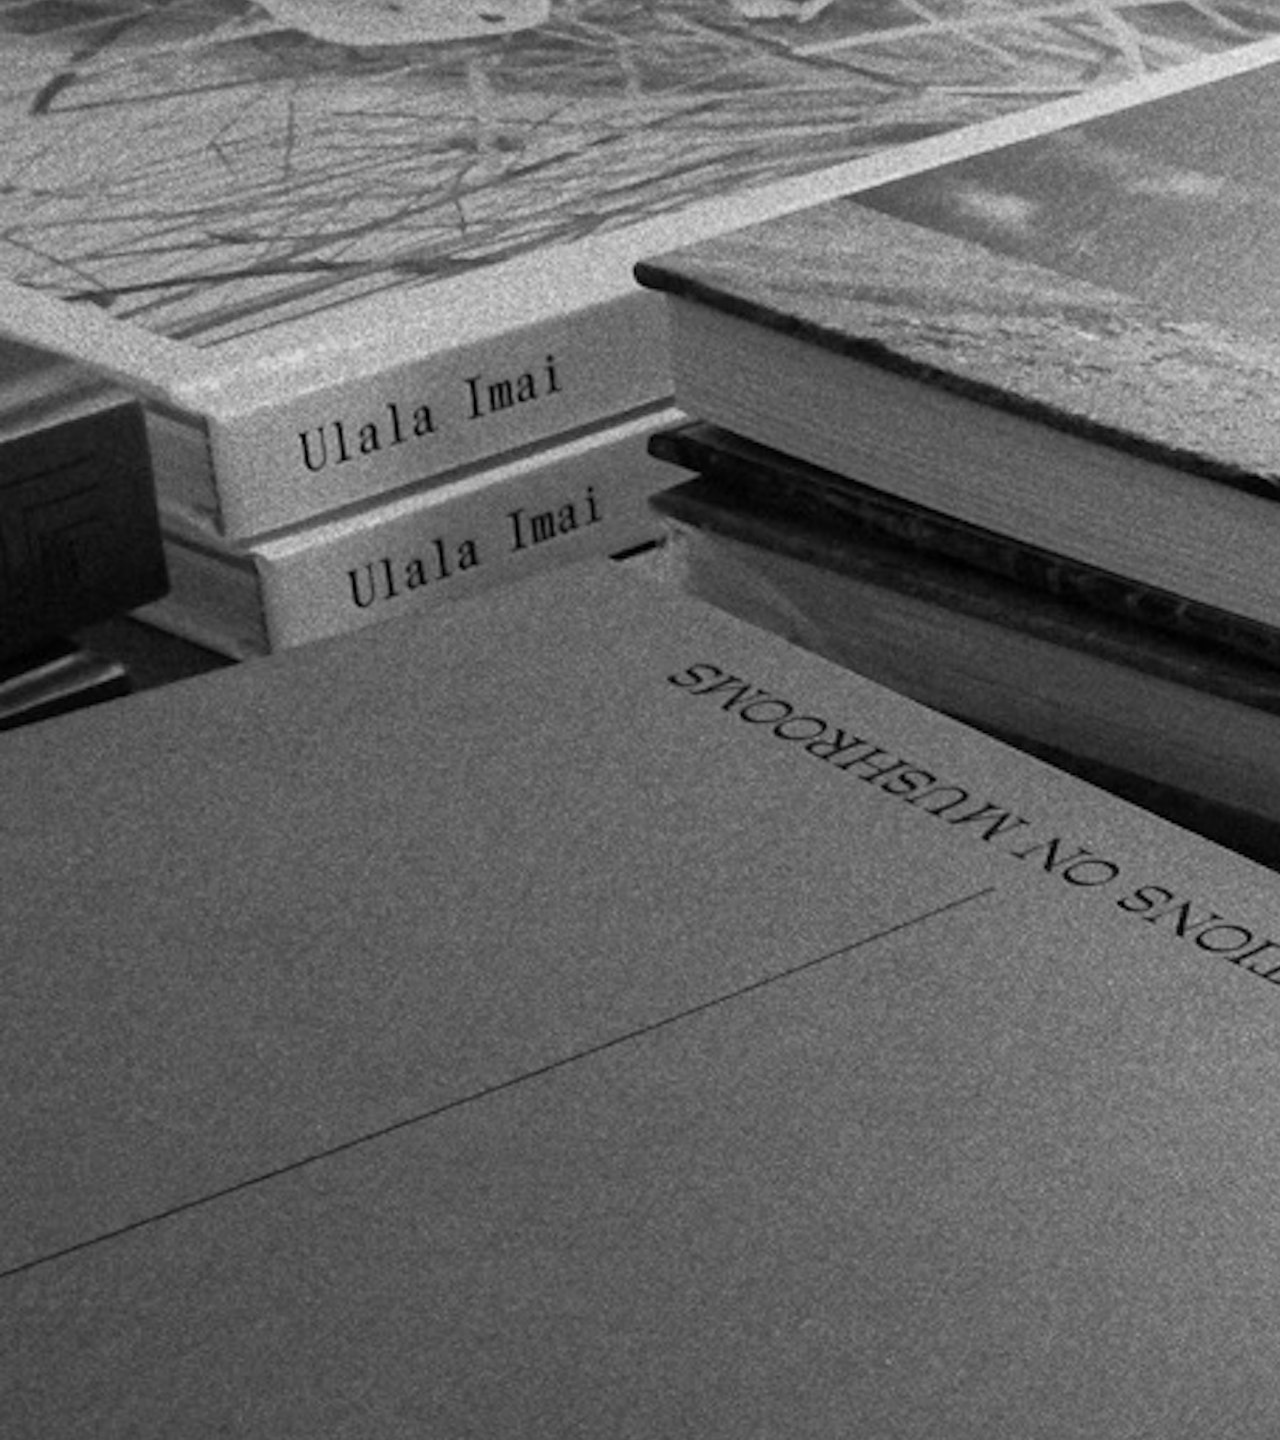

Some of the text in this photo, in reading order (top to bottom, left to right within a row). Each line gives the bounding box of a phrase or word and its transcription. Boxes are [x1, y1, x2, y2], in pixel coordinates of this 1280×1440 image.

[299, 354, 562, 472] Ulala Imai
[348, 486, 601, 608] Ulala Imai
[666, 661, 1028, 846] MUSHROOMS
[1018, 836, 1121, 888] ON
